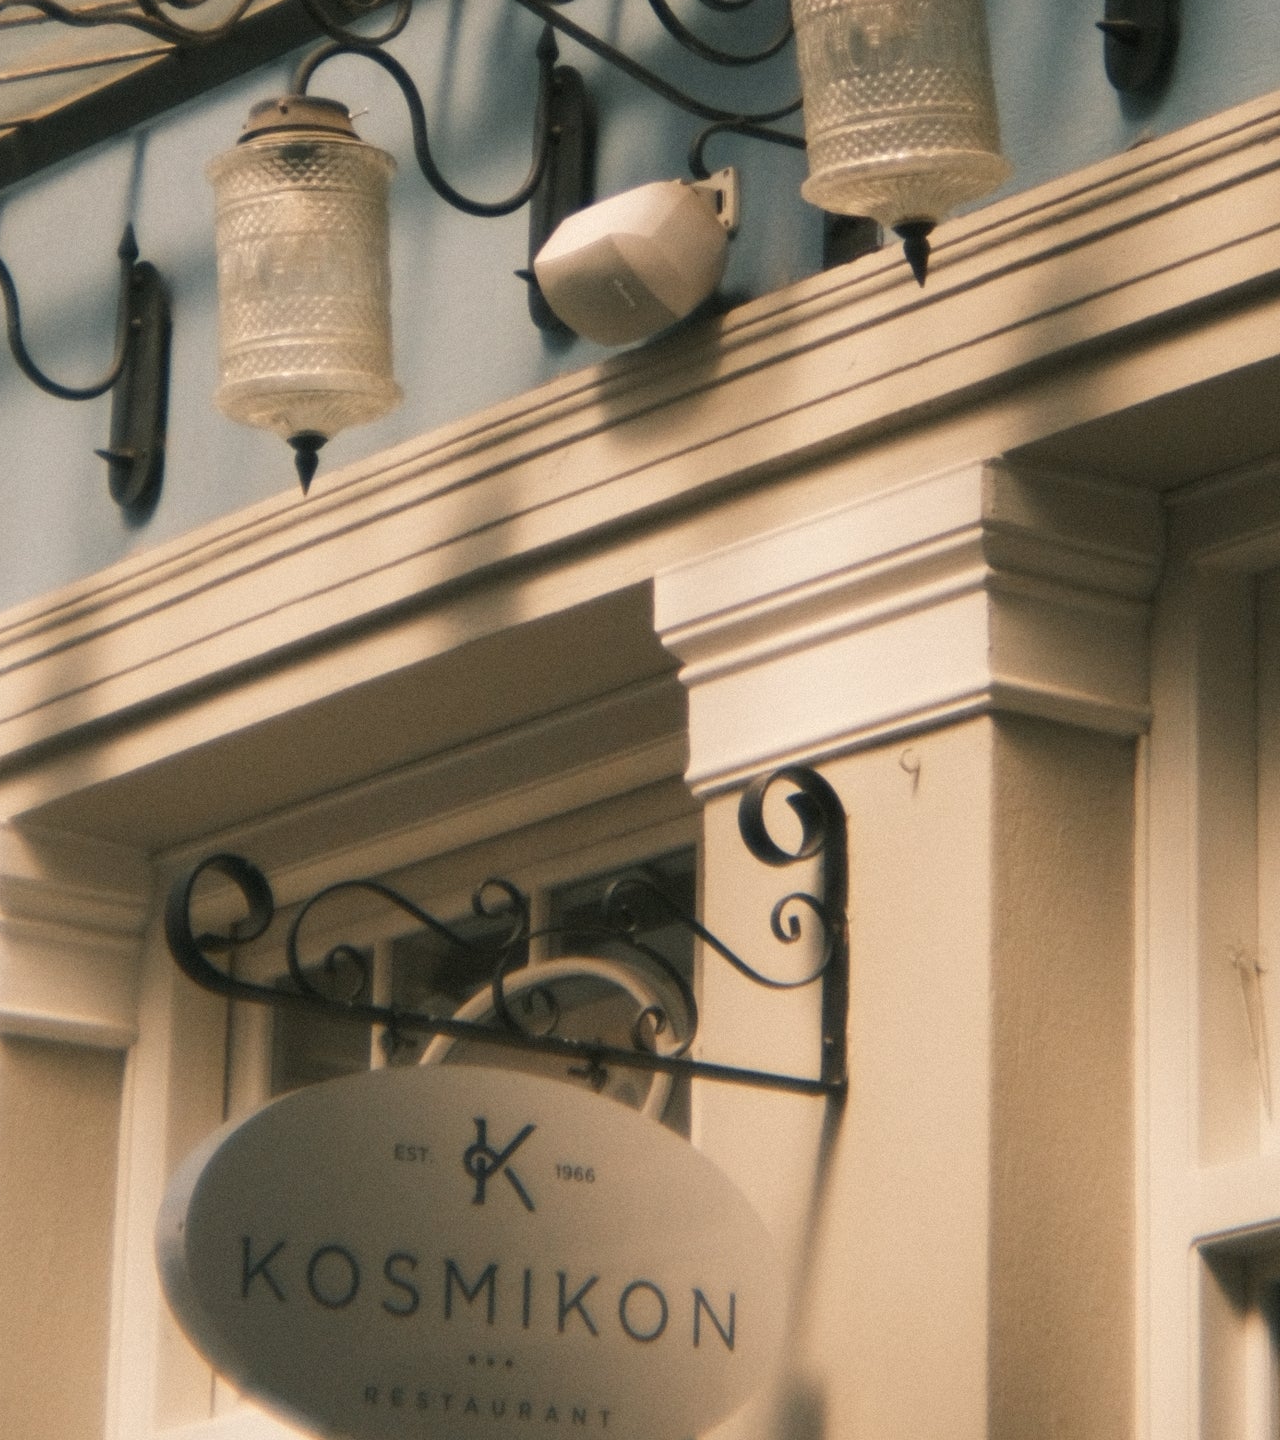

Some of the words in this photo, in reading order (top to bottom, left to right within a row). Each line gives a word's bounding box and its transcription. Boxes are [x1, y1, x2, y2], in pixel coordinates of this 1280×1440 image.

[555, 1163, 596, 1184] 1966
[241, 1235, 737, 1351] KOSMIKON
[364, 1385, 611, 1429] RESTAURANT
